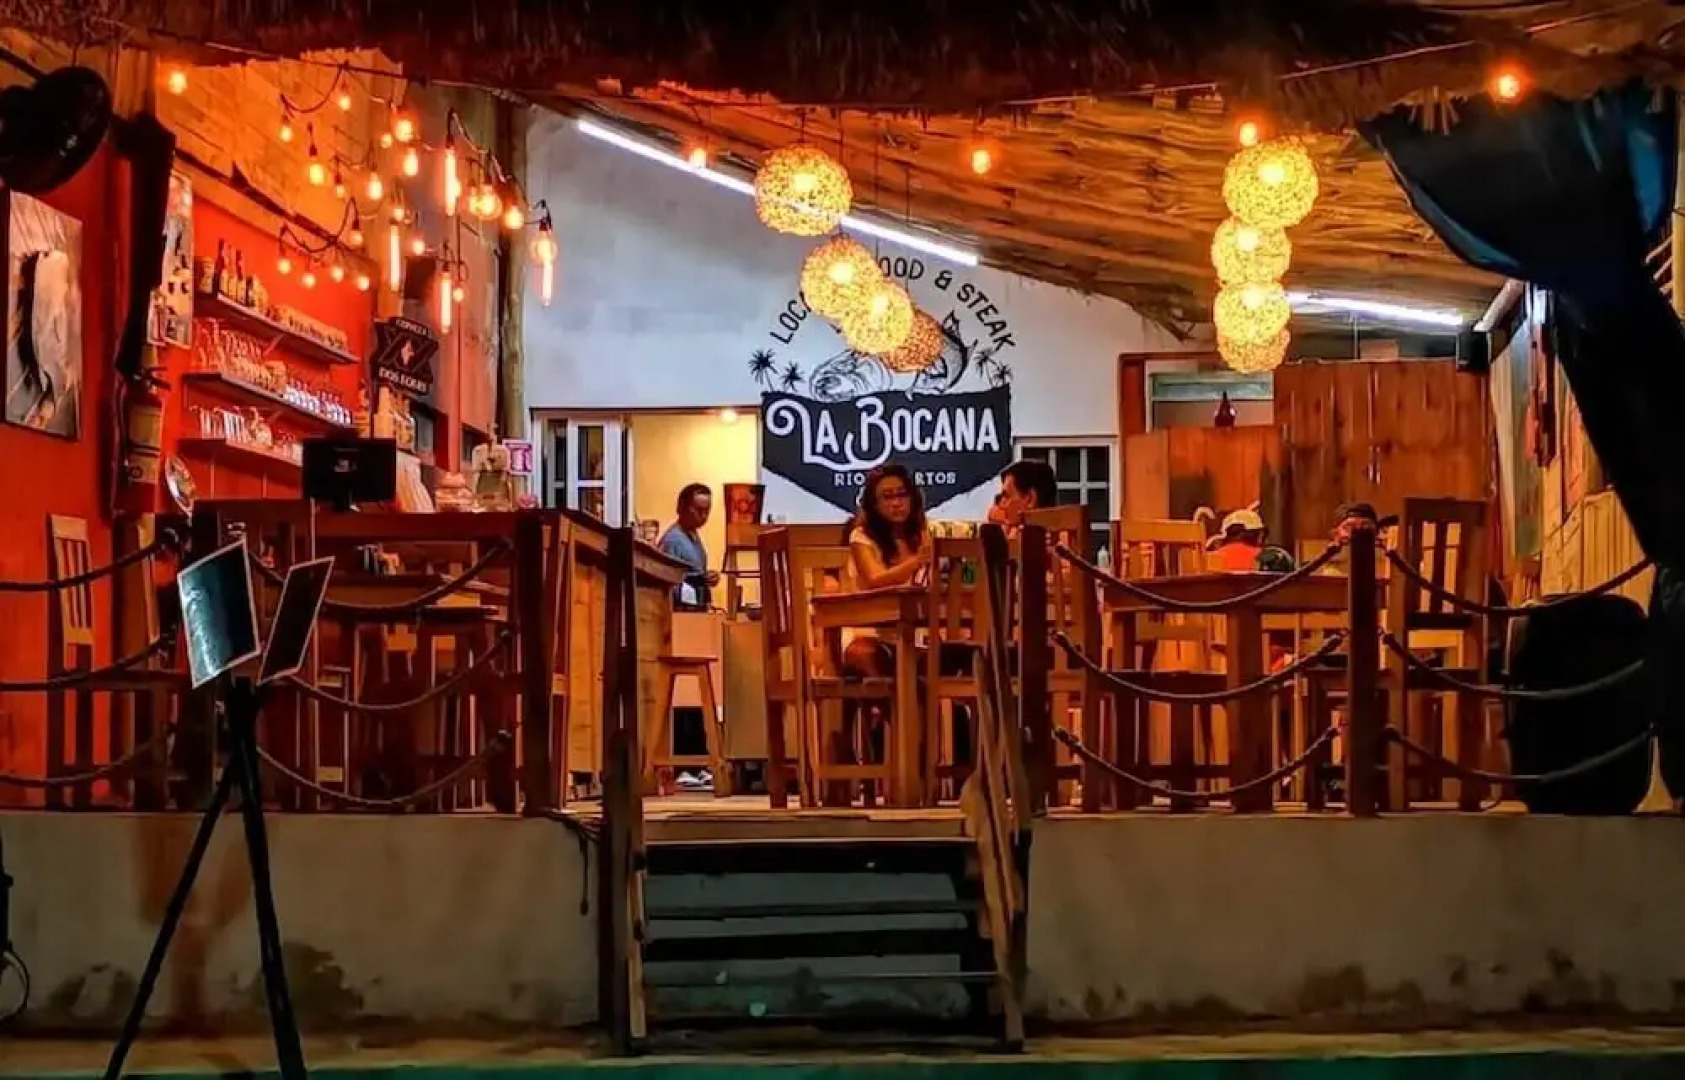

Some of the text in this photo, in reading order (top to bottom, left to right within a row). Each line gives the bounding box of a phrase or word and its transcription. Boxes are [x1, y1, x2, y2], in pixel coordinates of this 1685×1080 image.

[879, 255, 924, 280] OOD
[934, 269, 953, 290] &
[956, 283, 1016, 351] STEAK
[766, 397, 1000, 471] LA BOCANA
[834, 471, 957, 486] RIO RTOS
